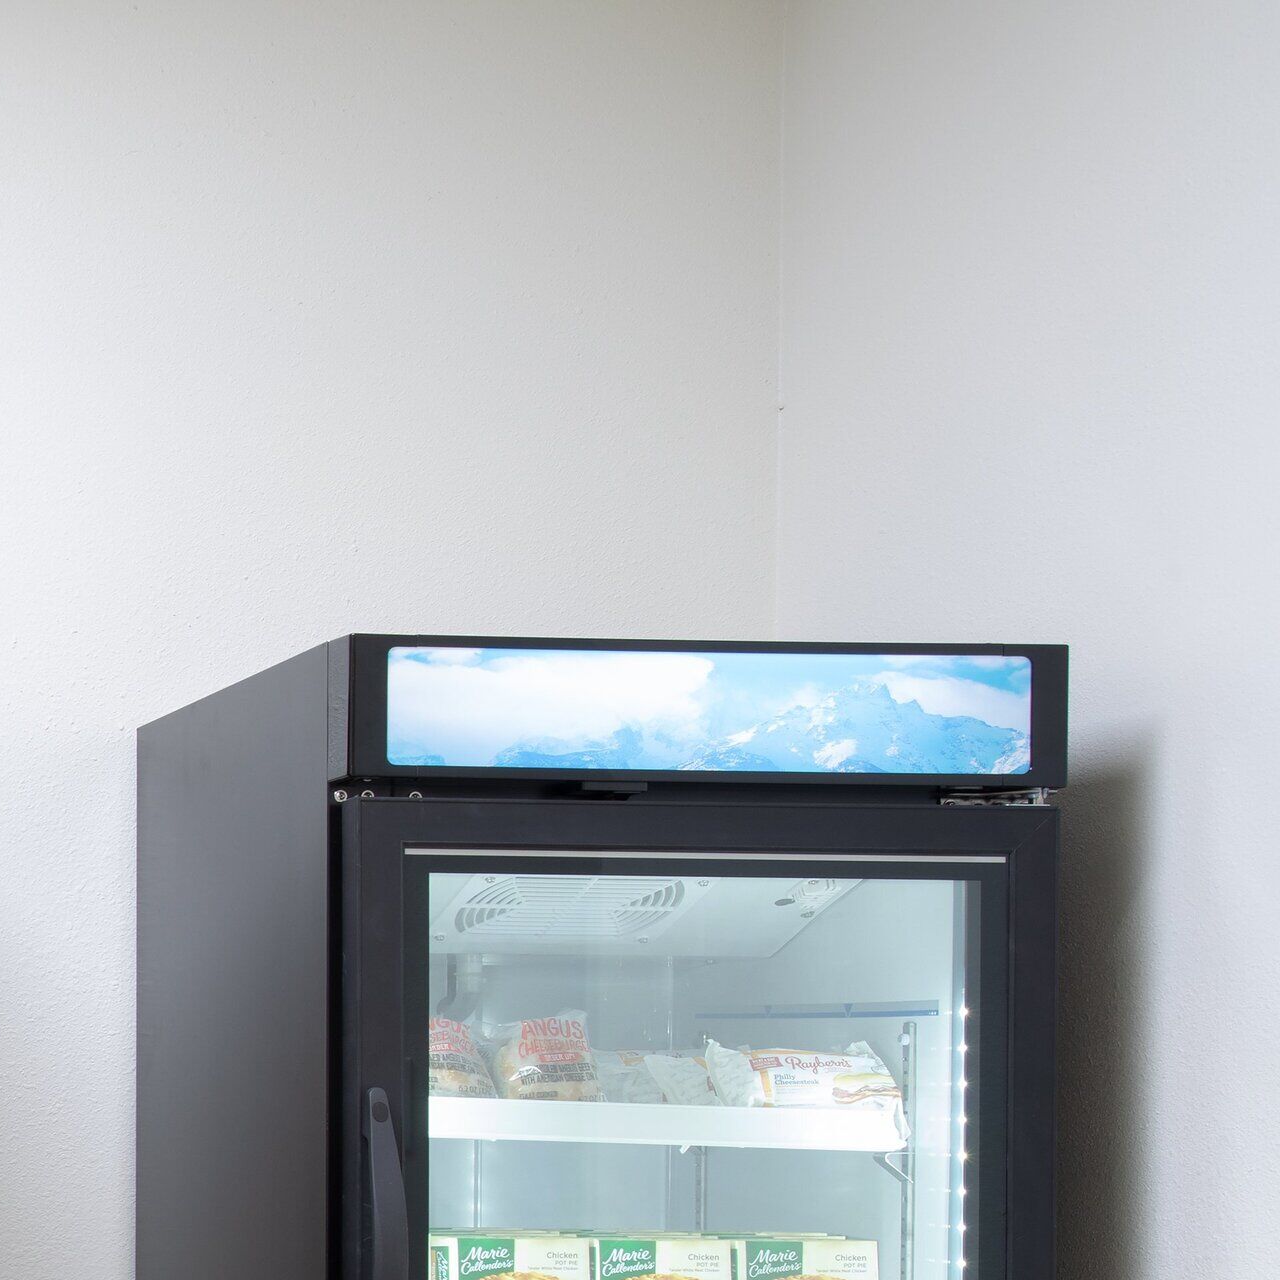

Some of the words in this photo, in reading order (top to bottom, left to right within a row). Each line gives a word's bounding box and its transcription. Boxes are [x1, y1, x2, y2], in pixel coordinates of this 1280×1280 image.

[521, 1017, 585, 1040] ANGUS
[774, 1073, 796, 1081] Philly
[461, 1246, 510, 1263] Marie
[546, 1251, 578, 1259] Chicken
[602, 1248, 652, 1264] Marie
[687, 1253, 720, 1261] Chicken
[749, 1249, 798, 1265] Marie
[461, 1259, 514, 1275] Callender's
[602, 1261, 655, 1277] Callender's
[749, 1262, 802, 1278] Callender's
